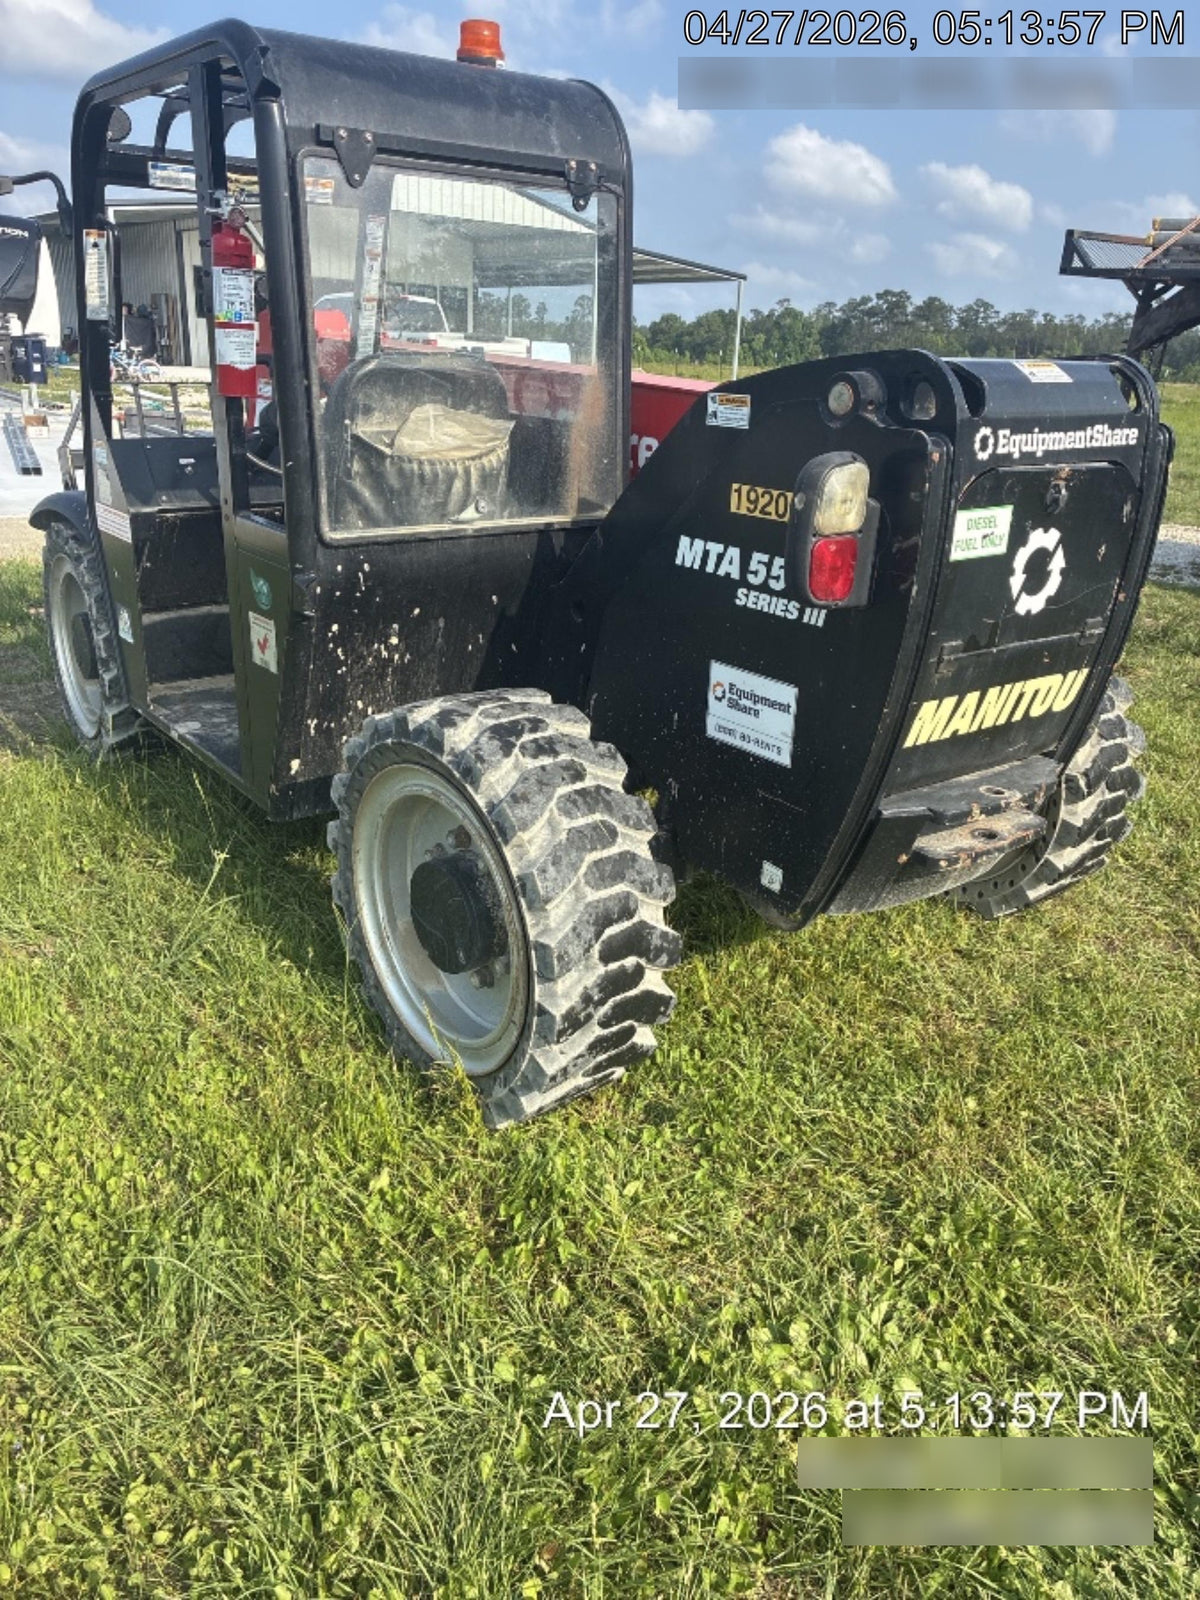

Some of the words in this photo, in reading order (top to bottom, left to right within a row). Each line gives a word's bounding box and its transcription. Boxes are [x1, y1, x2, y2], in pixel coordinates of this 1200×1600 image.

[995, 424, 1139, 459] EquipmentShare
[967, 515, 998, 531] DIESEL
[675, 534, 741, 580] MTA
[954, 537, 978, 552] FUEL
[735, 588, 801, 620] SERIES
[802, 607, 828, 628] III
[727, 696, 760, 719] Share
[728, 682, 792, 715] Equipment
[903, 668, 1090, 749] MANITOU
